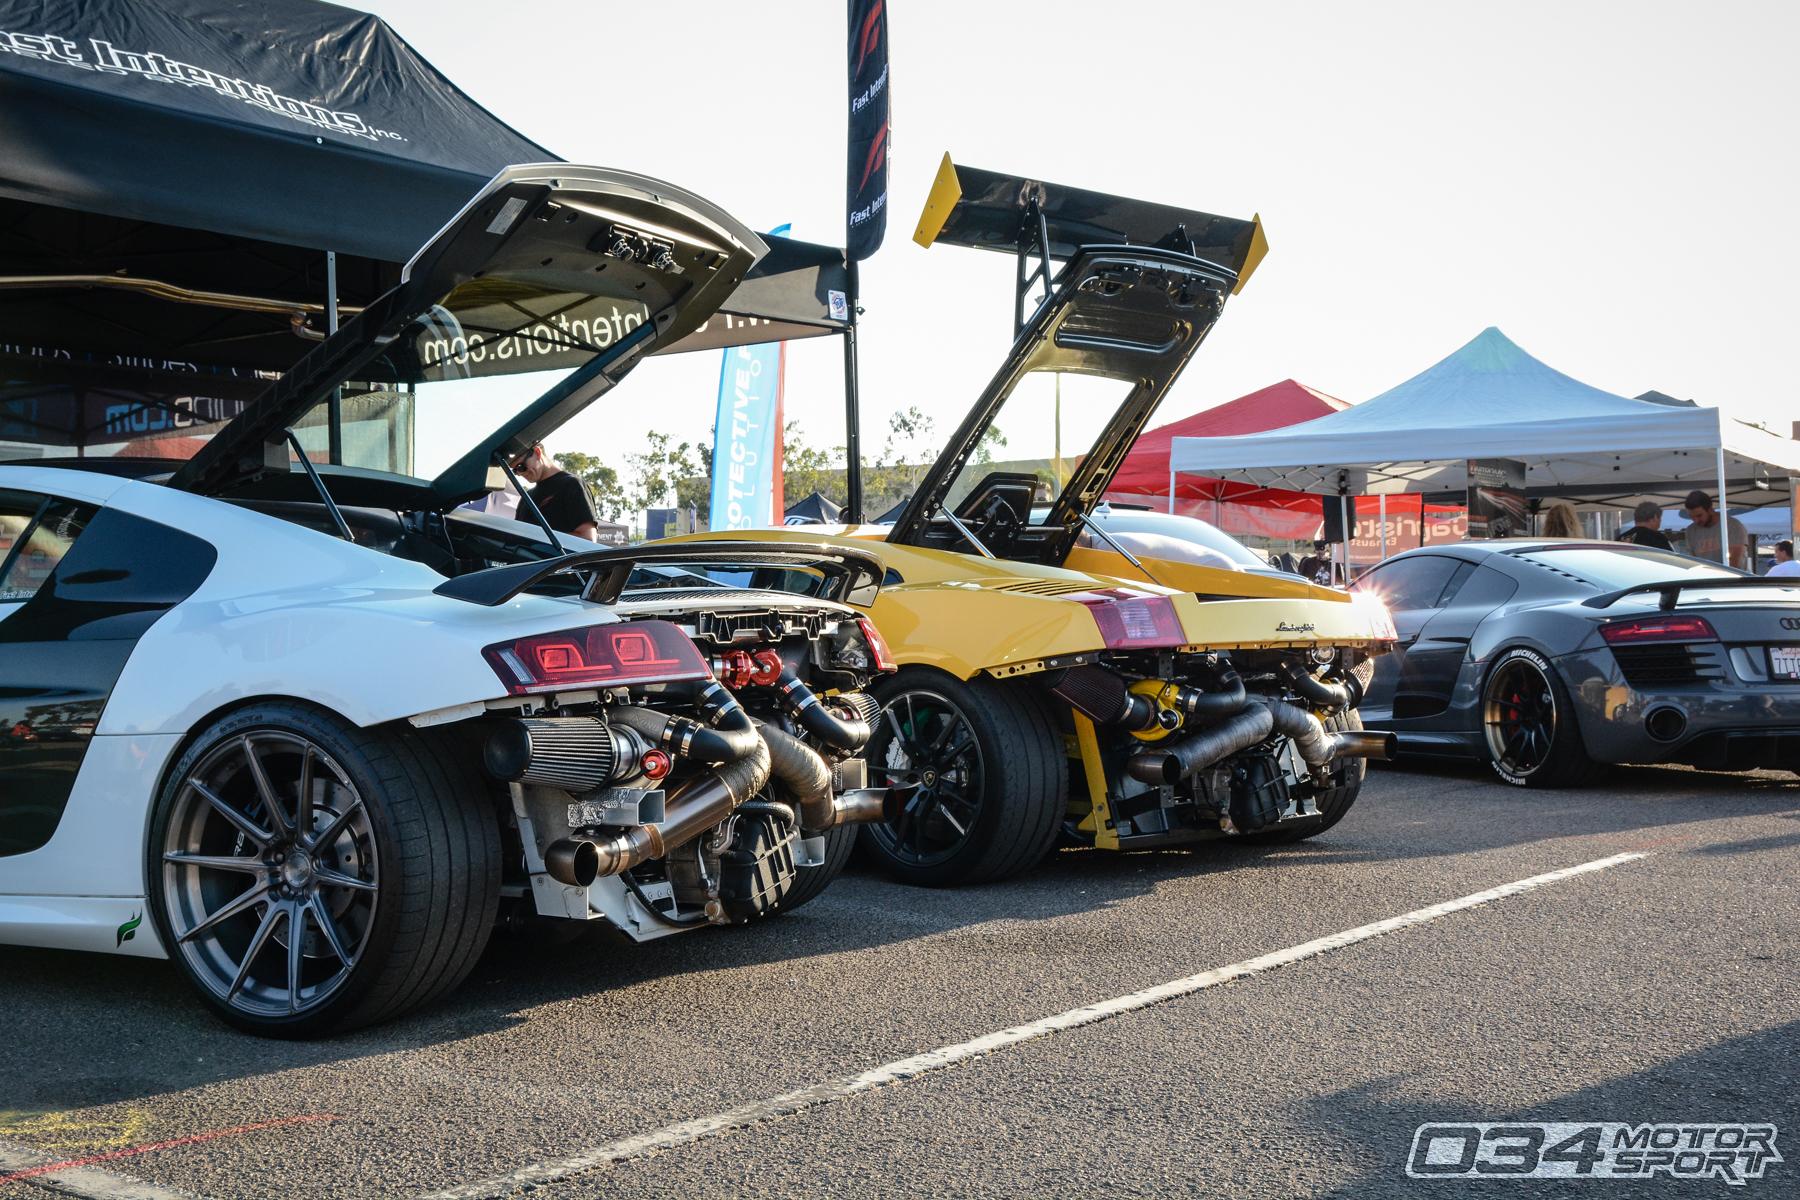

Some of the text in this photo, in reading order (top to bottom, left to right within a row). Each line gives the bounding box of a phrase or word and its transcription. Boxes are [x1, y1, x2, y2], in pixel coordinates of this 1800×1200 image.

[89, 37, 368, 133] Intentions
[852, 90, 869, 113] Fast
[850, 205, 870, 226] Fast
[1510, 649, 1549, 671] MICHELIN
[1491, 760, 1526, 785] MICHELIN
